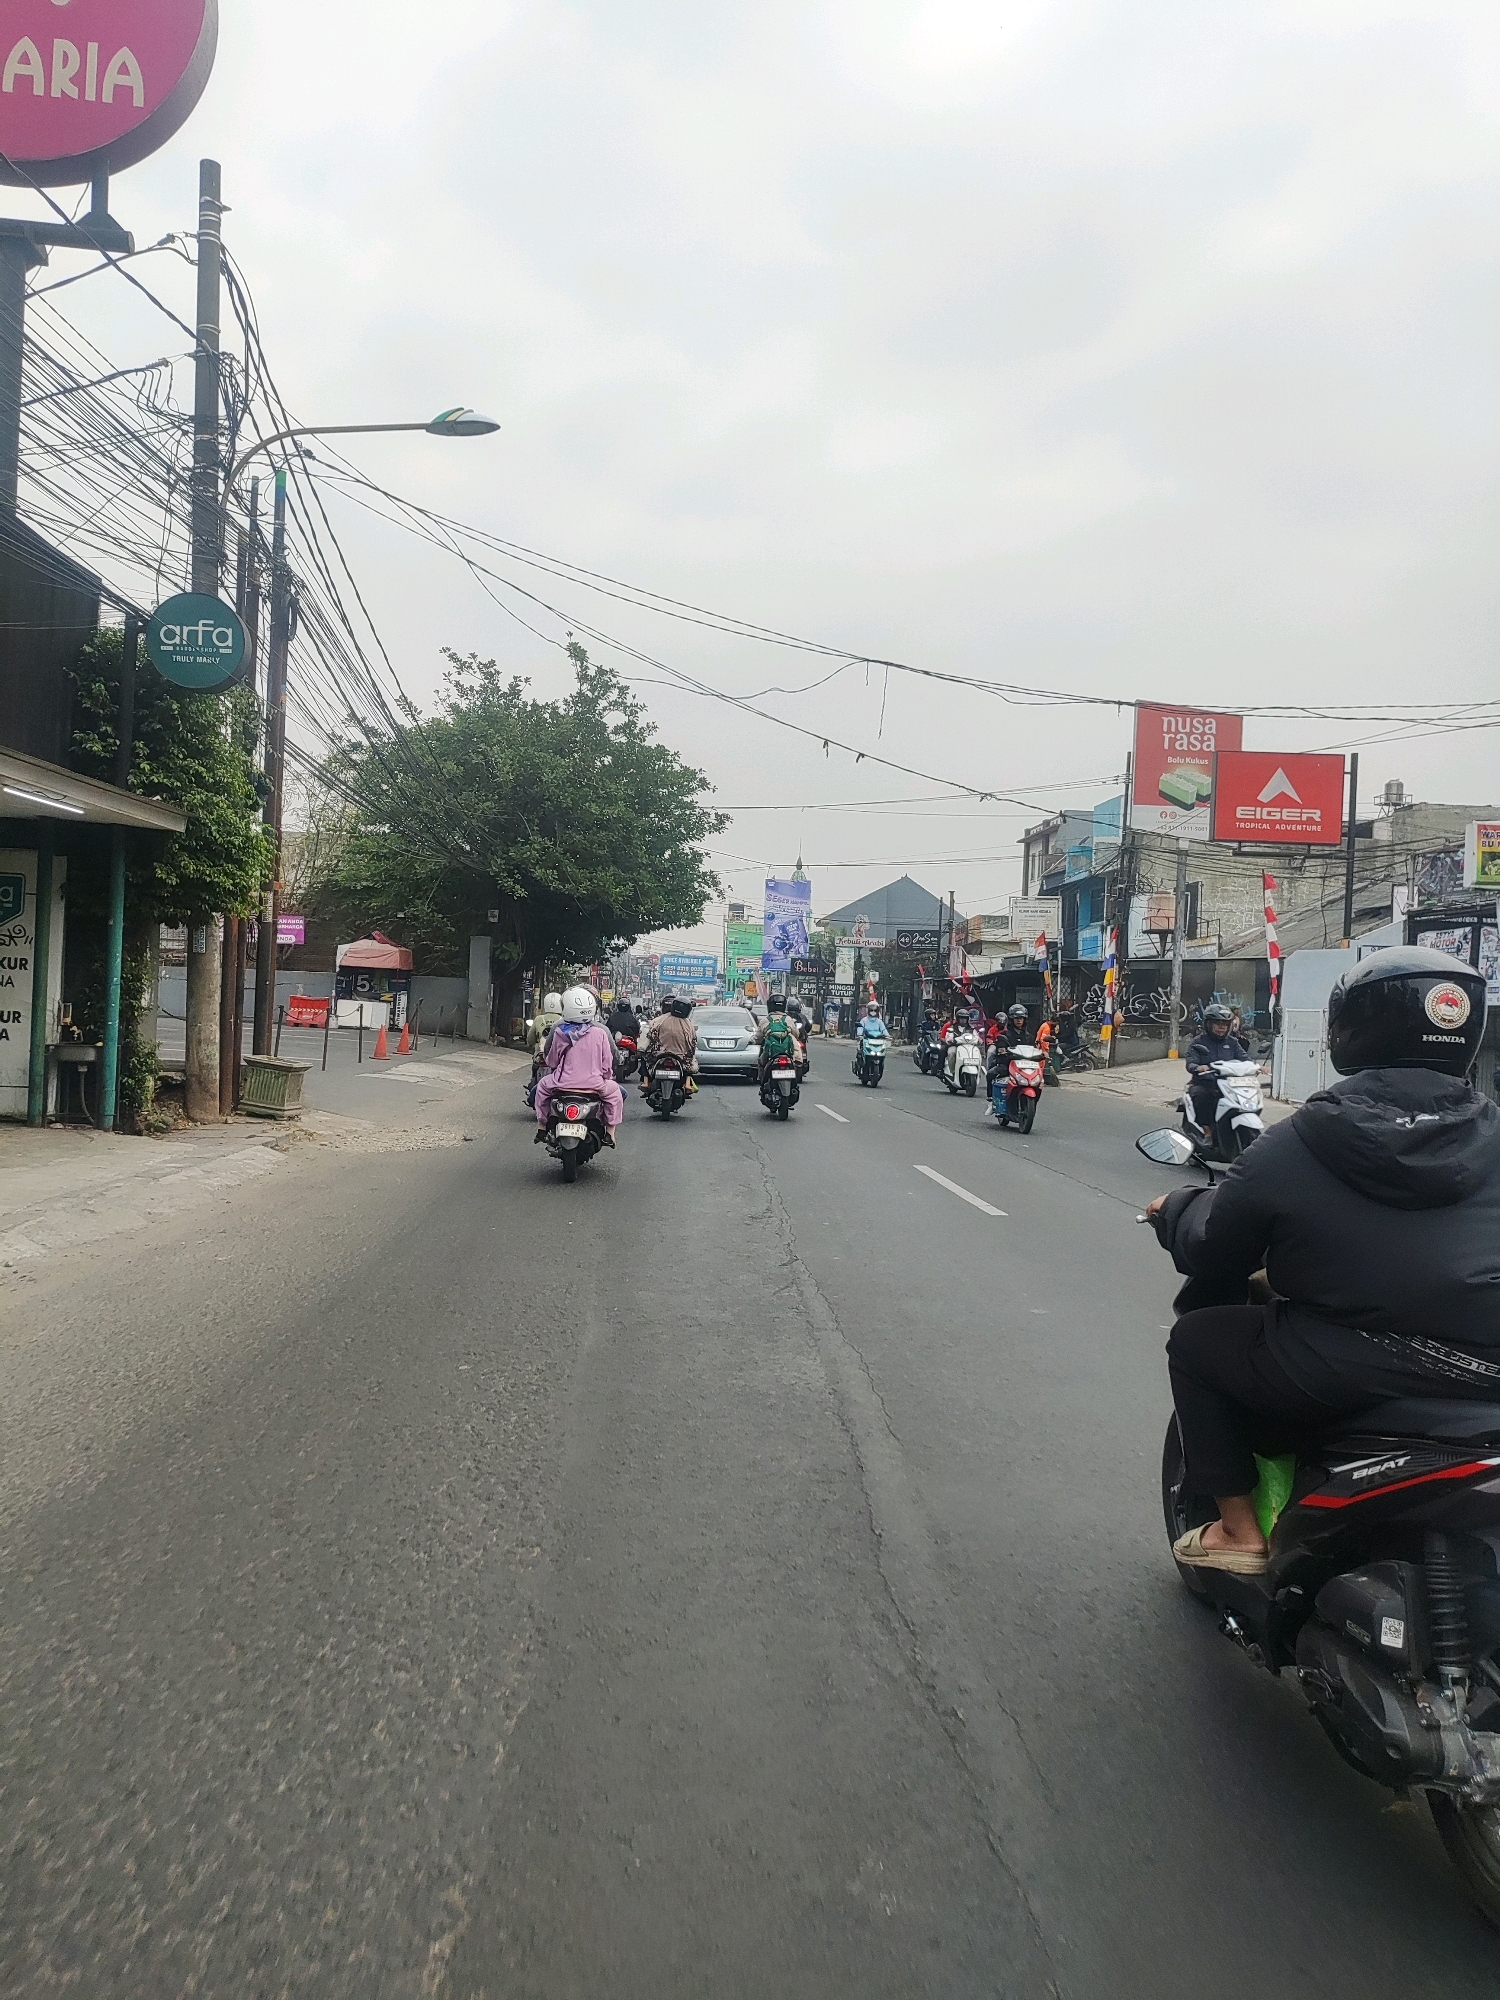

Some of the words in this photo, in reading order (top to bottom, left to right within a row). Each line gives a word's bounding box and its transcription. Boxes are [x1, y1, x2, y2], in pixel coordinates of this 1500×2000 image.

[160, 620, 233, 647] arfa
[172, 655, 195, 663] TRULY
[1162, 716, 1217, 735] nusa
[1162, 733, 1215, 752] rasa
[1167, 756, 1185, 764] Bolu
[1185, 756, 1209, 765] Kukus
[1236, 806, 1322, 822] EIGER
[1235, 822, 1271, 830] TROPICAL
[1275, 823, 1322, 832] ADVENTURE
[1482, 840, 1494, 848] BU
[1422, 1034, 1466, 1044] HONDA
